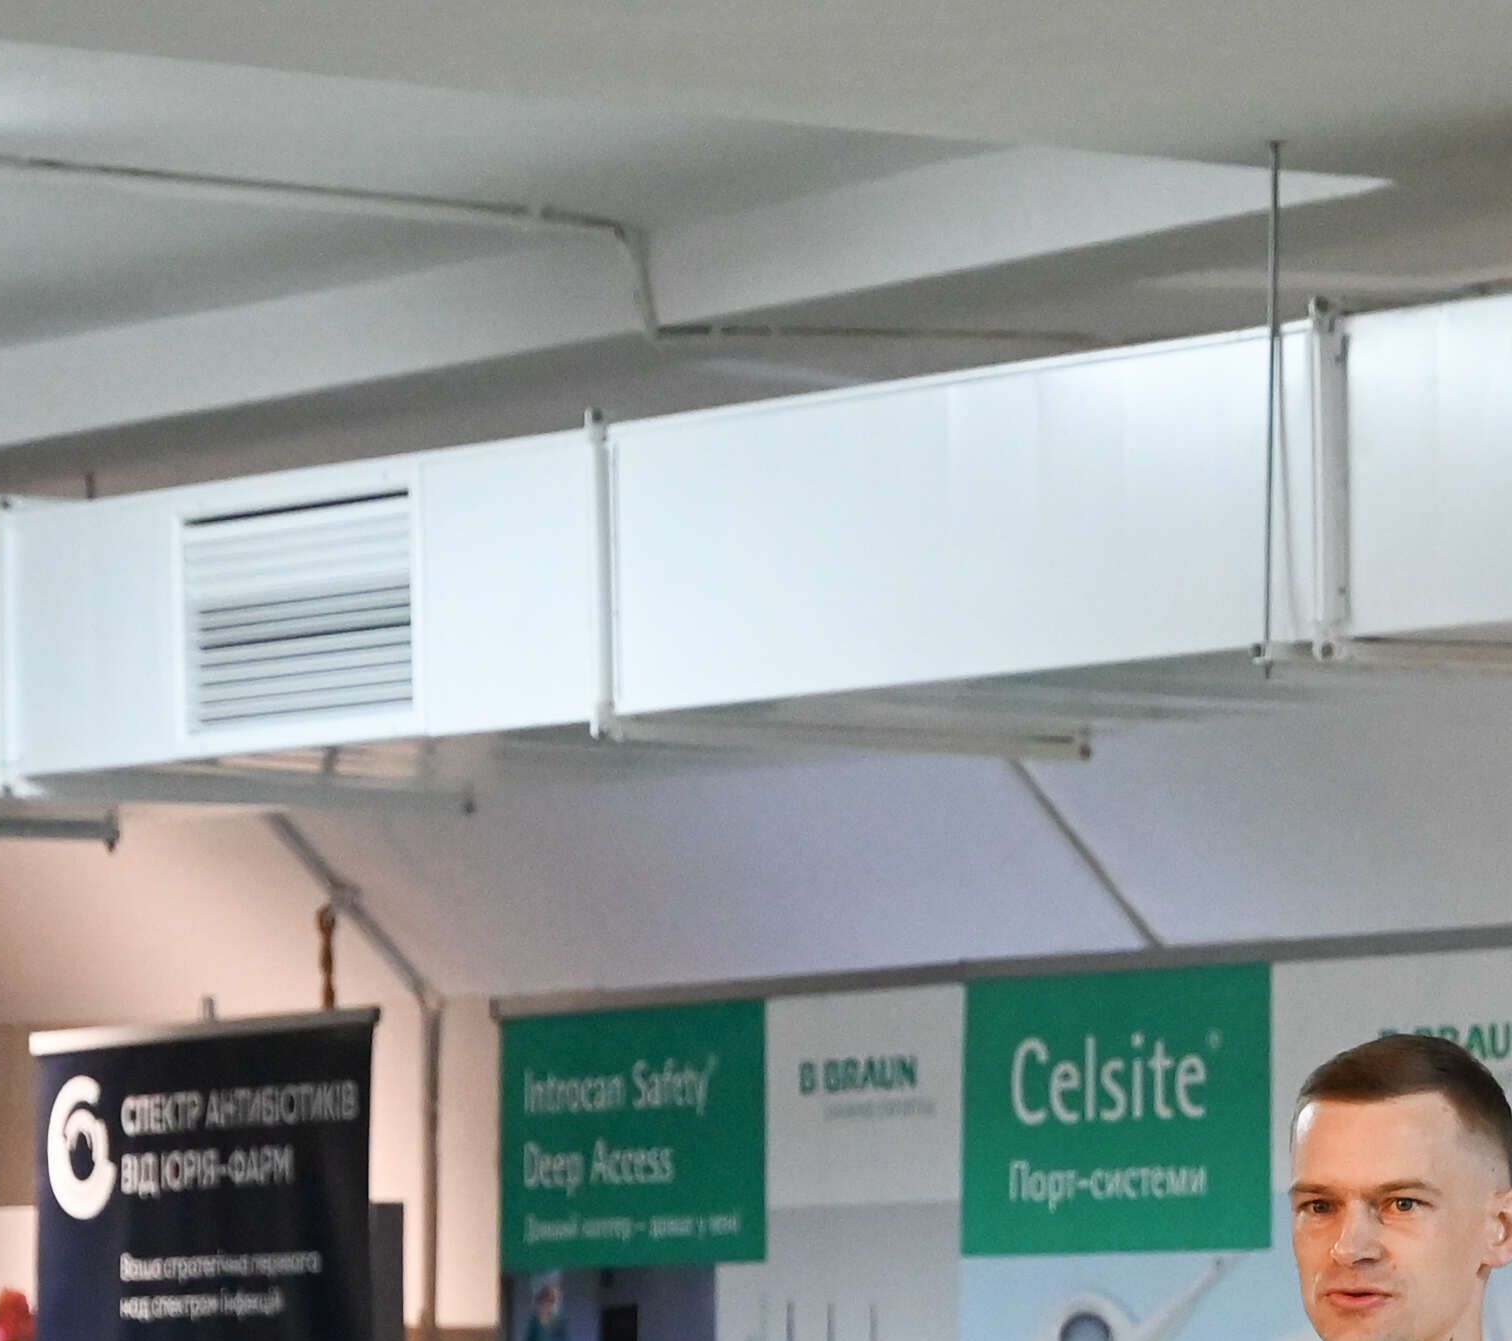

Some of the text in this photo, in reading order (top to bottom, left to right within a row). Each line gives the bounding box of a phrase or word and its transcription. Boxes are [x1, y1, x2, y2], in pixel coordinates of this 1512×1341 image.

[120, 1079, 360, 1137] СПЕКТР АНТИБІОТИКІВ
[120, 1144, 295, 1200] ВІД ЮРІЯ-ФАРМ
[523, 1137, 676, 1198] Deep Access
[1008, 1160, 1208, 1214] Порт-системи
